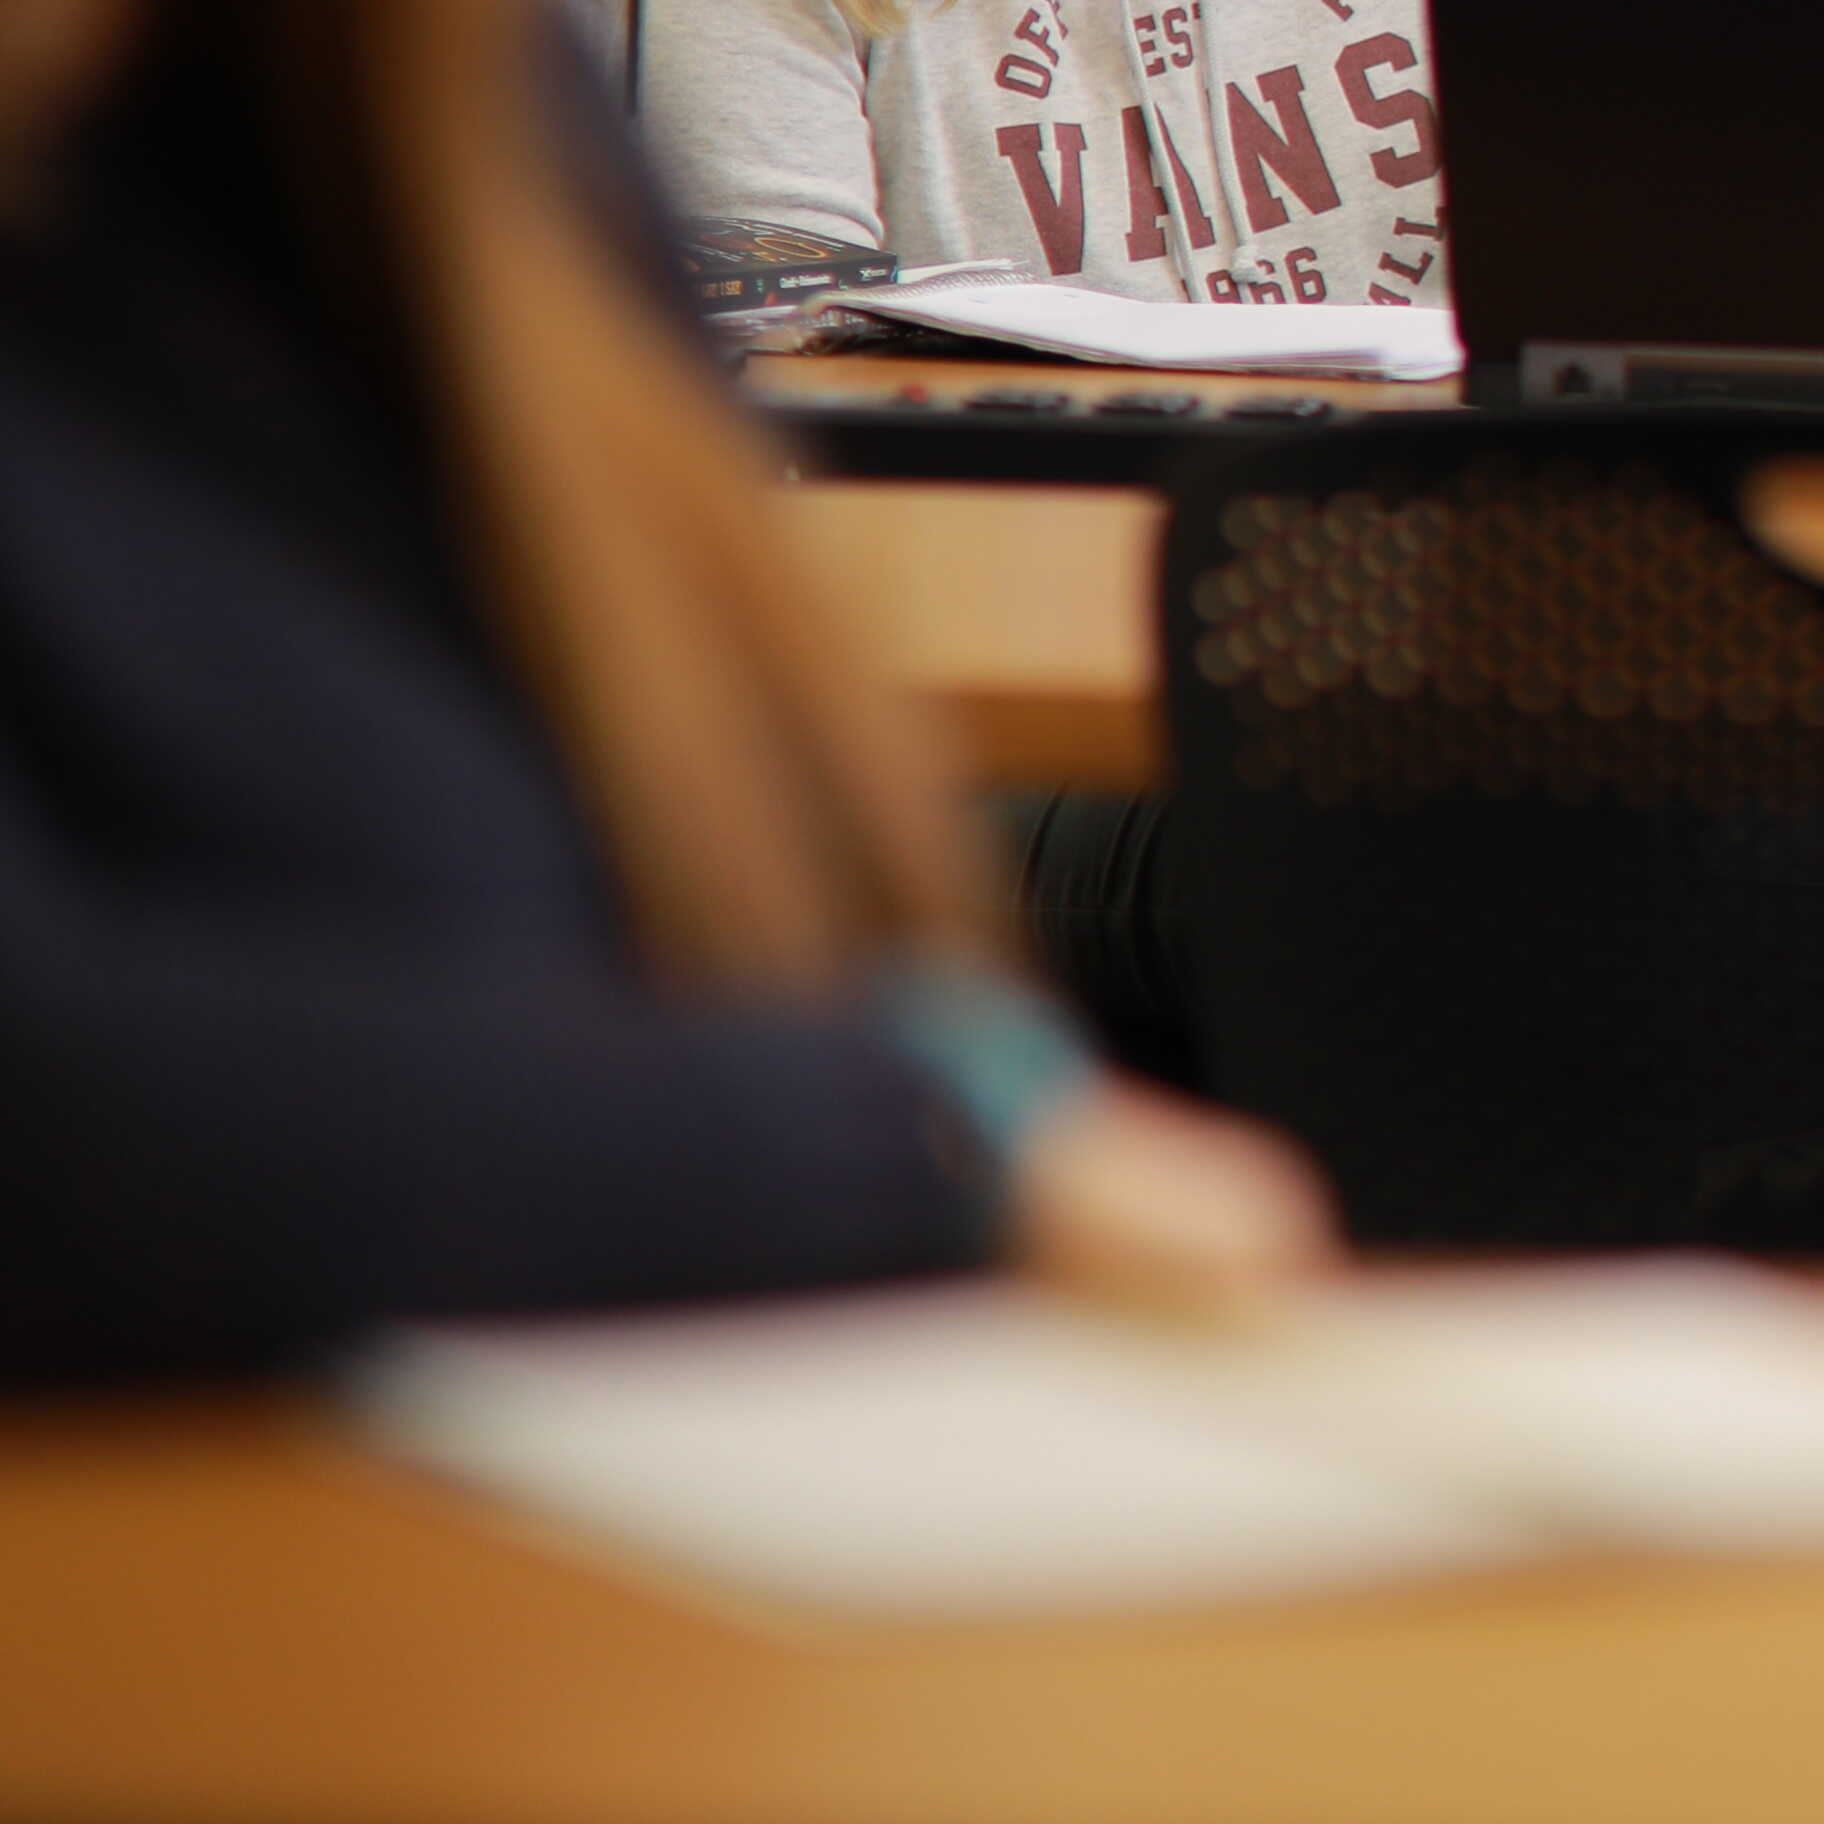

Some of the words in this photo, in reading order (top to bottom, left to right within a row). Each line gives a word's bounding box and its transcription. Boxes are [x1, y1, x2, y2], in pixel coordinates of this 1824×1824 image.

[1132, 0, 1201, 77] ES
[995, 32, 1443, 277] VANS
[1180, 246, 1327, 304] 966
